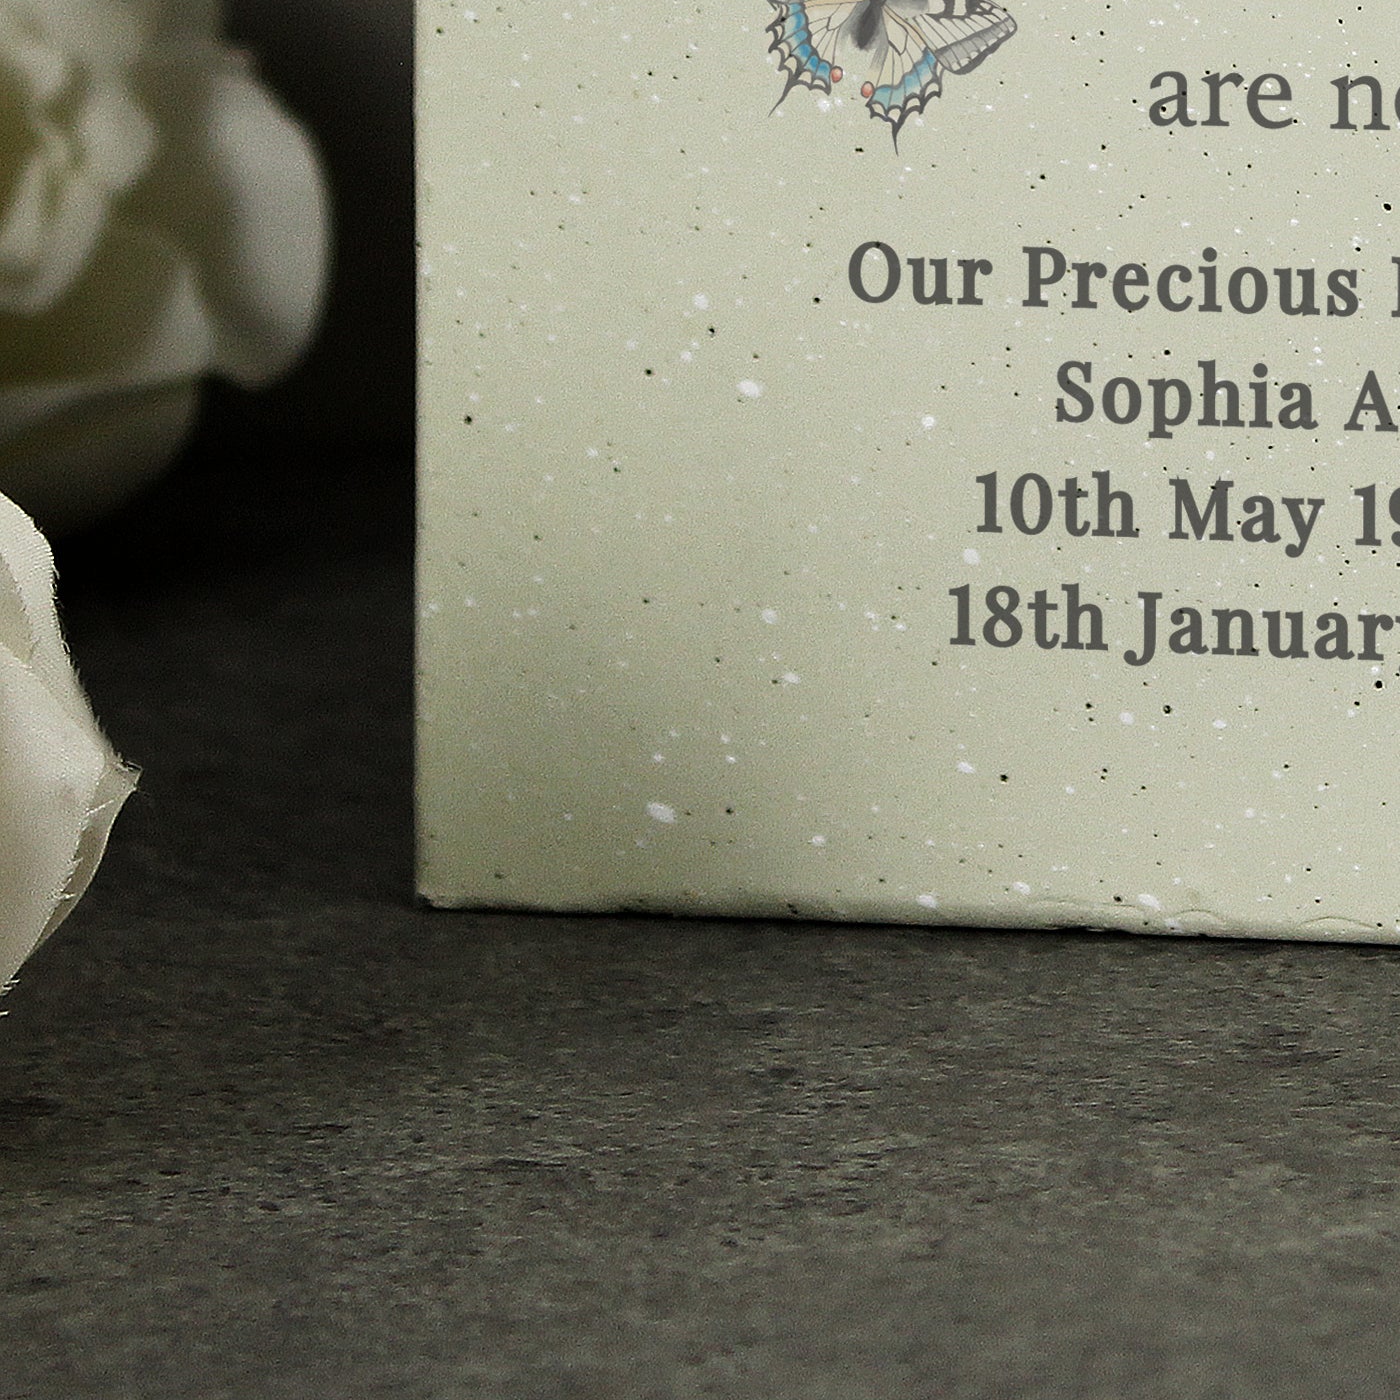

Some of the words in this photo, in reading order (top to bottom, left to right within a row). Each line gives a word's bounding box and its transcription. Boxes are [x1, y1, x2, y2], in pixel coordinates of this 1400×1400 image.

[1149, 71, 1292, 129] are
[849, 241, 993, 305] Our
[1022, 246, 1358, 317] Precious
[1055, 359, 1319, 439] Sophia
[976, 470, 1140, 538] 10th
[1169, 476, 1325, 558] May
[949, 583, 1108, 651] 18th
